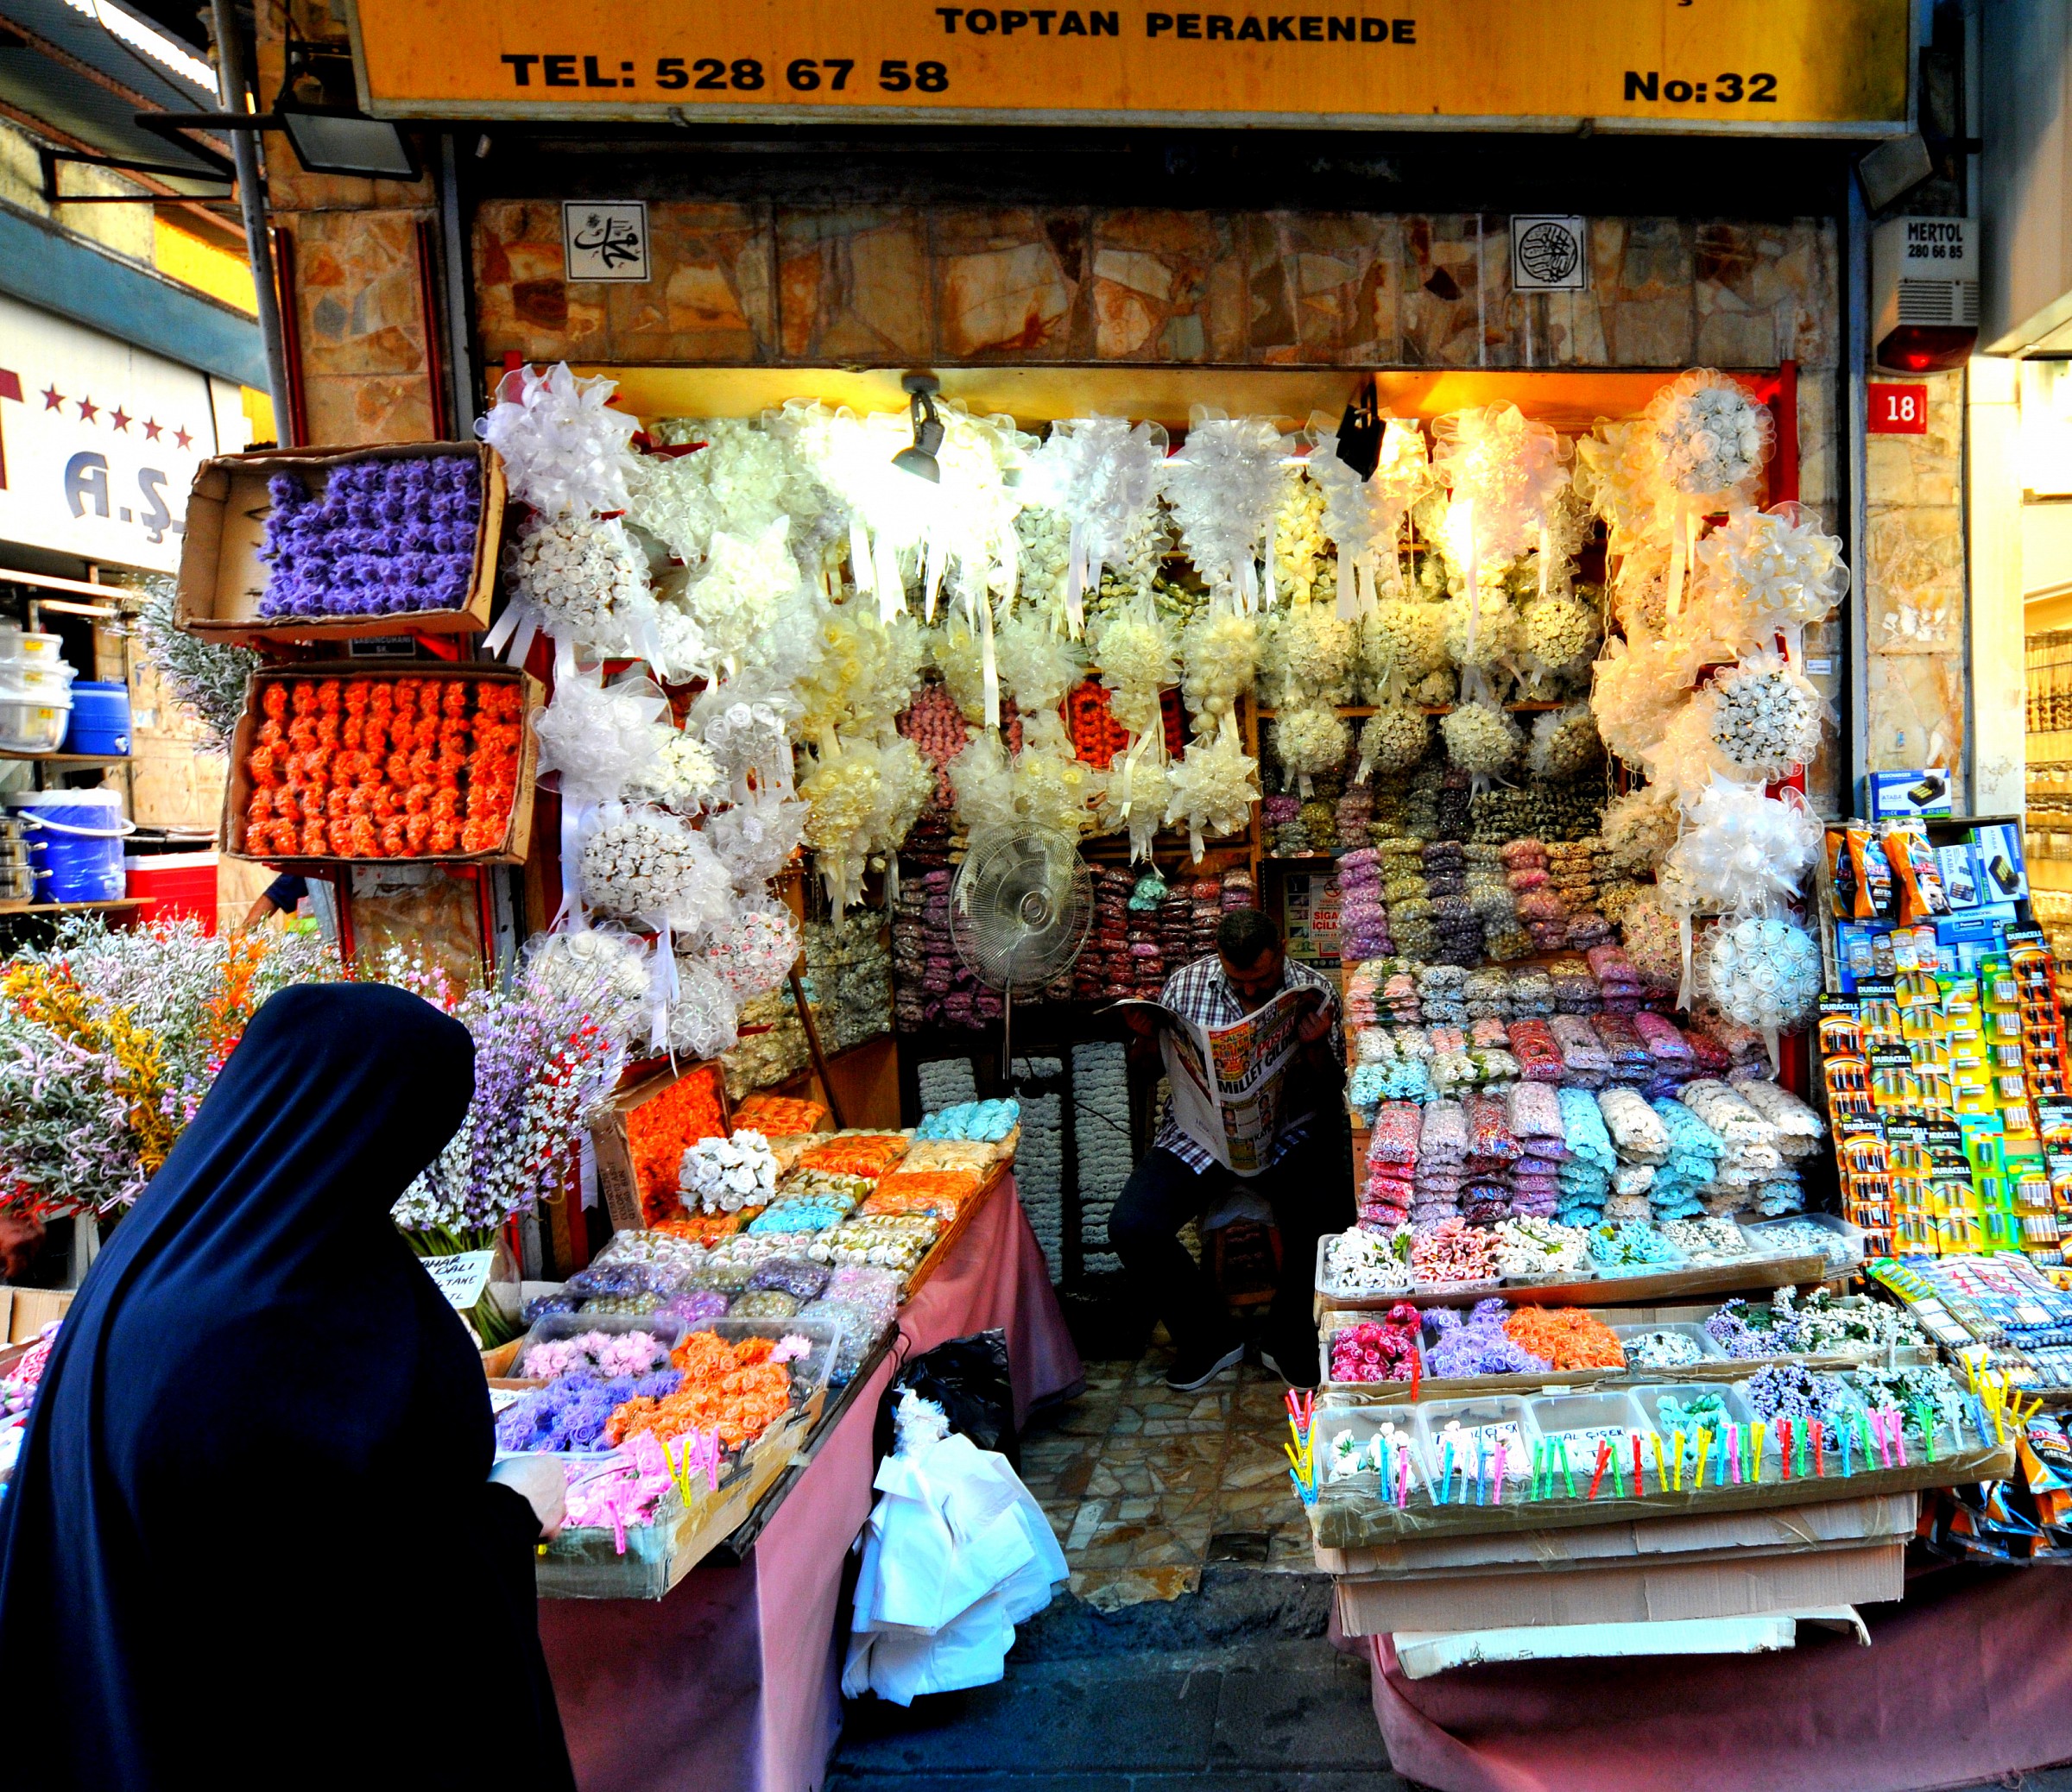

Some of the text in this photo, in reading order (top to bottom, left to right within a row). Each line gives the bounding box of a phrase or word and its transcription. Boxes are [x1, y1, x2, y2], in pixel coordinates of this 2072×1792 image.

[935, 8, 1417, 44] TOPTAN PERAKENDE
[501, 54, 950, 92] TEL: 528 67 58
[1908, 223, 1963, 243] MERTOL
[1908, 244, 1963, 259] 280 66 85
[1887, 395, 1915, 421] 18
[1945, 848, 1955, 874] ATABA
[2006, 931, 2043, 941] DURACELL
[1842, 1122, 1884, 1131] DURACELL
[1887, 1126, 1929, 1135] DURACELL
[1931, 1166, 1971, 1175] DURACELL
[422, 1255, 461, 1268] AHAR
